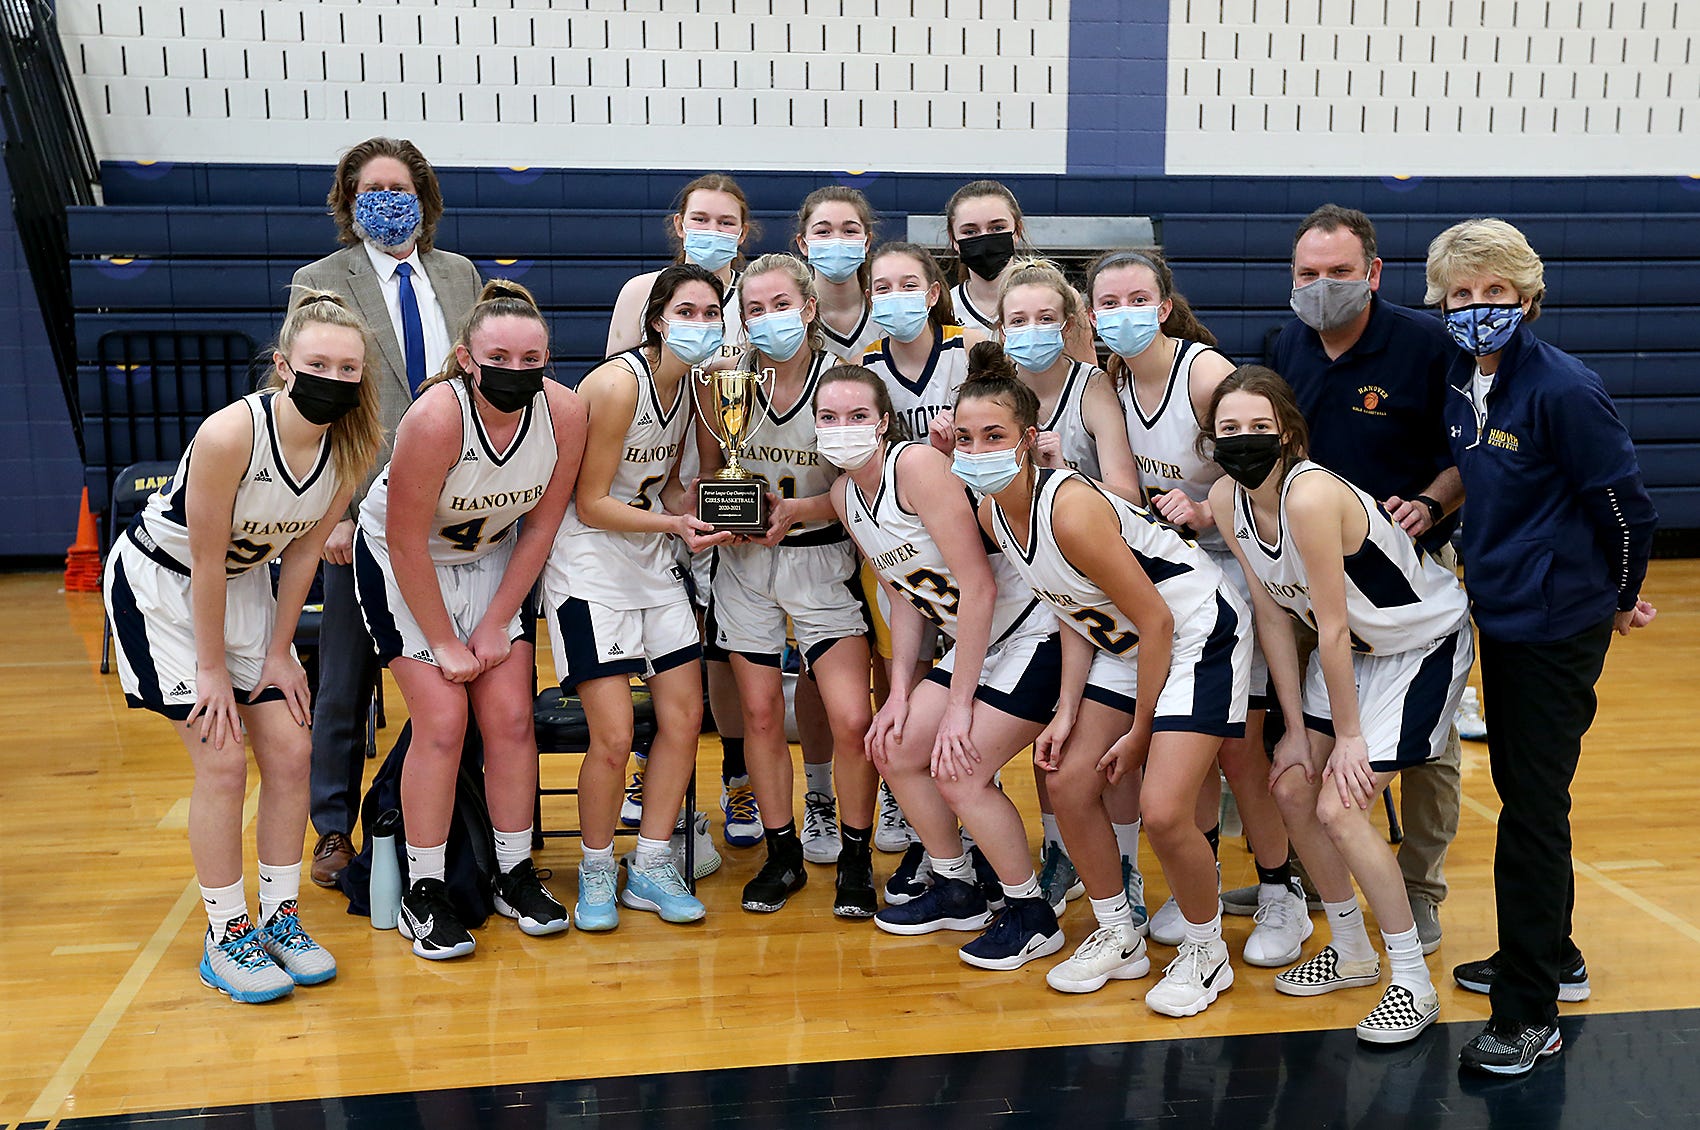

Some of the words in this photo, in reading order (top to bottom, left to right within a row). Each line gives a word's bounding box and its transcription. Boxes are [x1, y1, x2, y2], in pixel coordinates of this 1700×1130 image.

[1357, 385, 1389, 399] HANOVER
[897, 405, 953, 441] NOV
[450, 484, 544, 511] HANOVER
